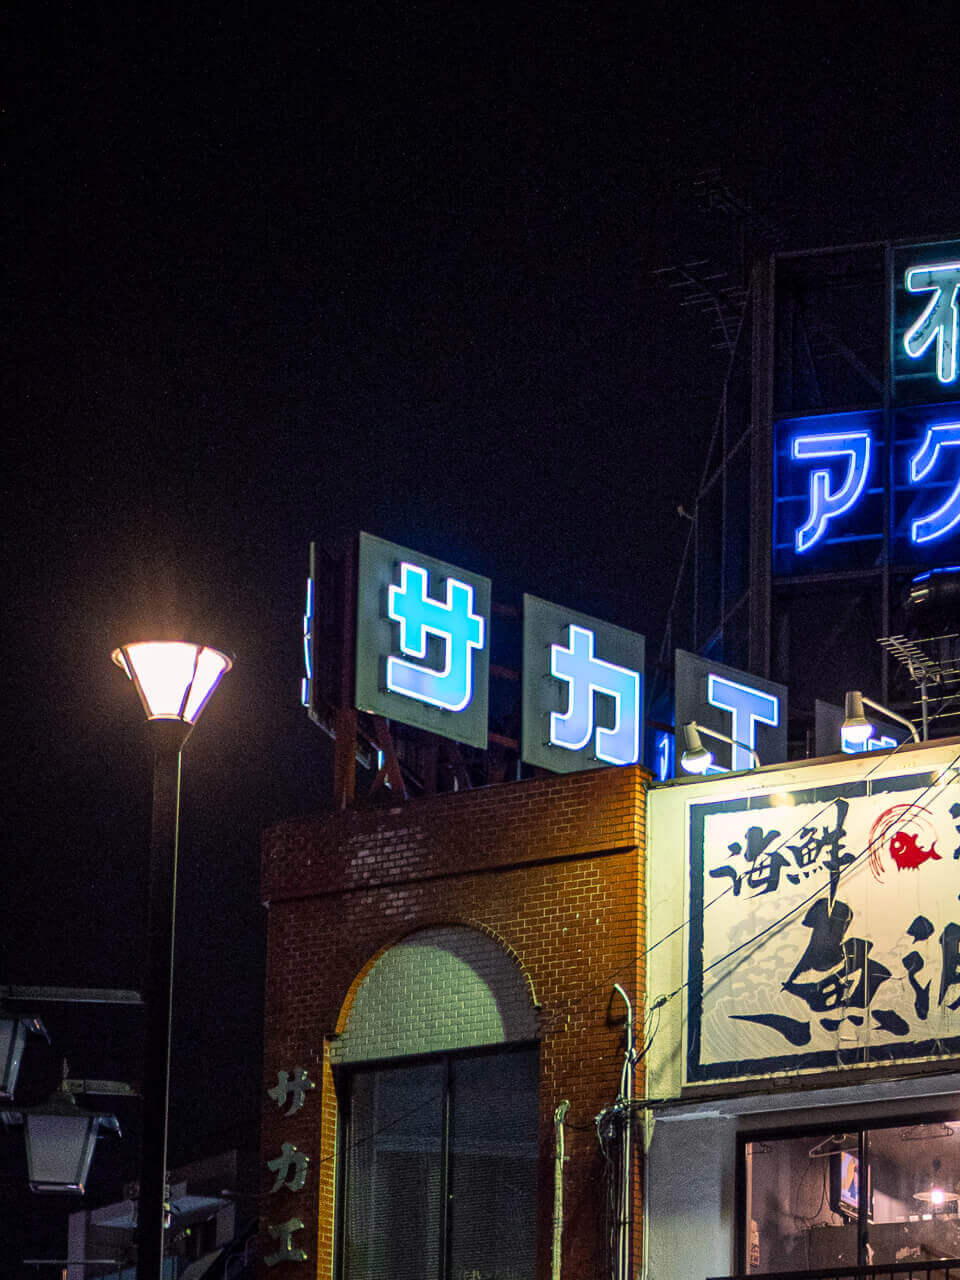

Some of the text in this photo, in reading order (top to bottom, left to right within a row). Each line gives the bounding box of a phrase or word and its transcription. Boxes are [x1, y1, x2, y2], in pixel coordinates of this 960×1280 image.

[387, 561, 898, 773] サカエ
[708, 797, 857, 906] 海鮮
